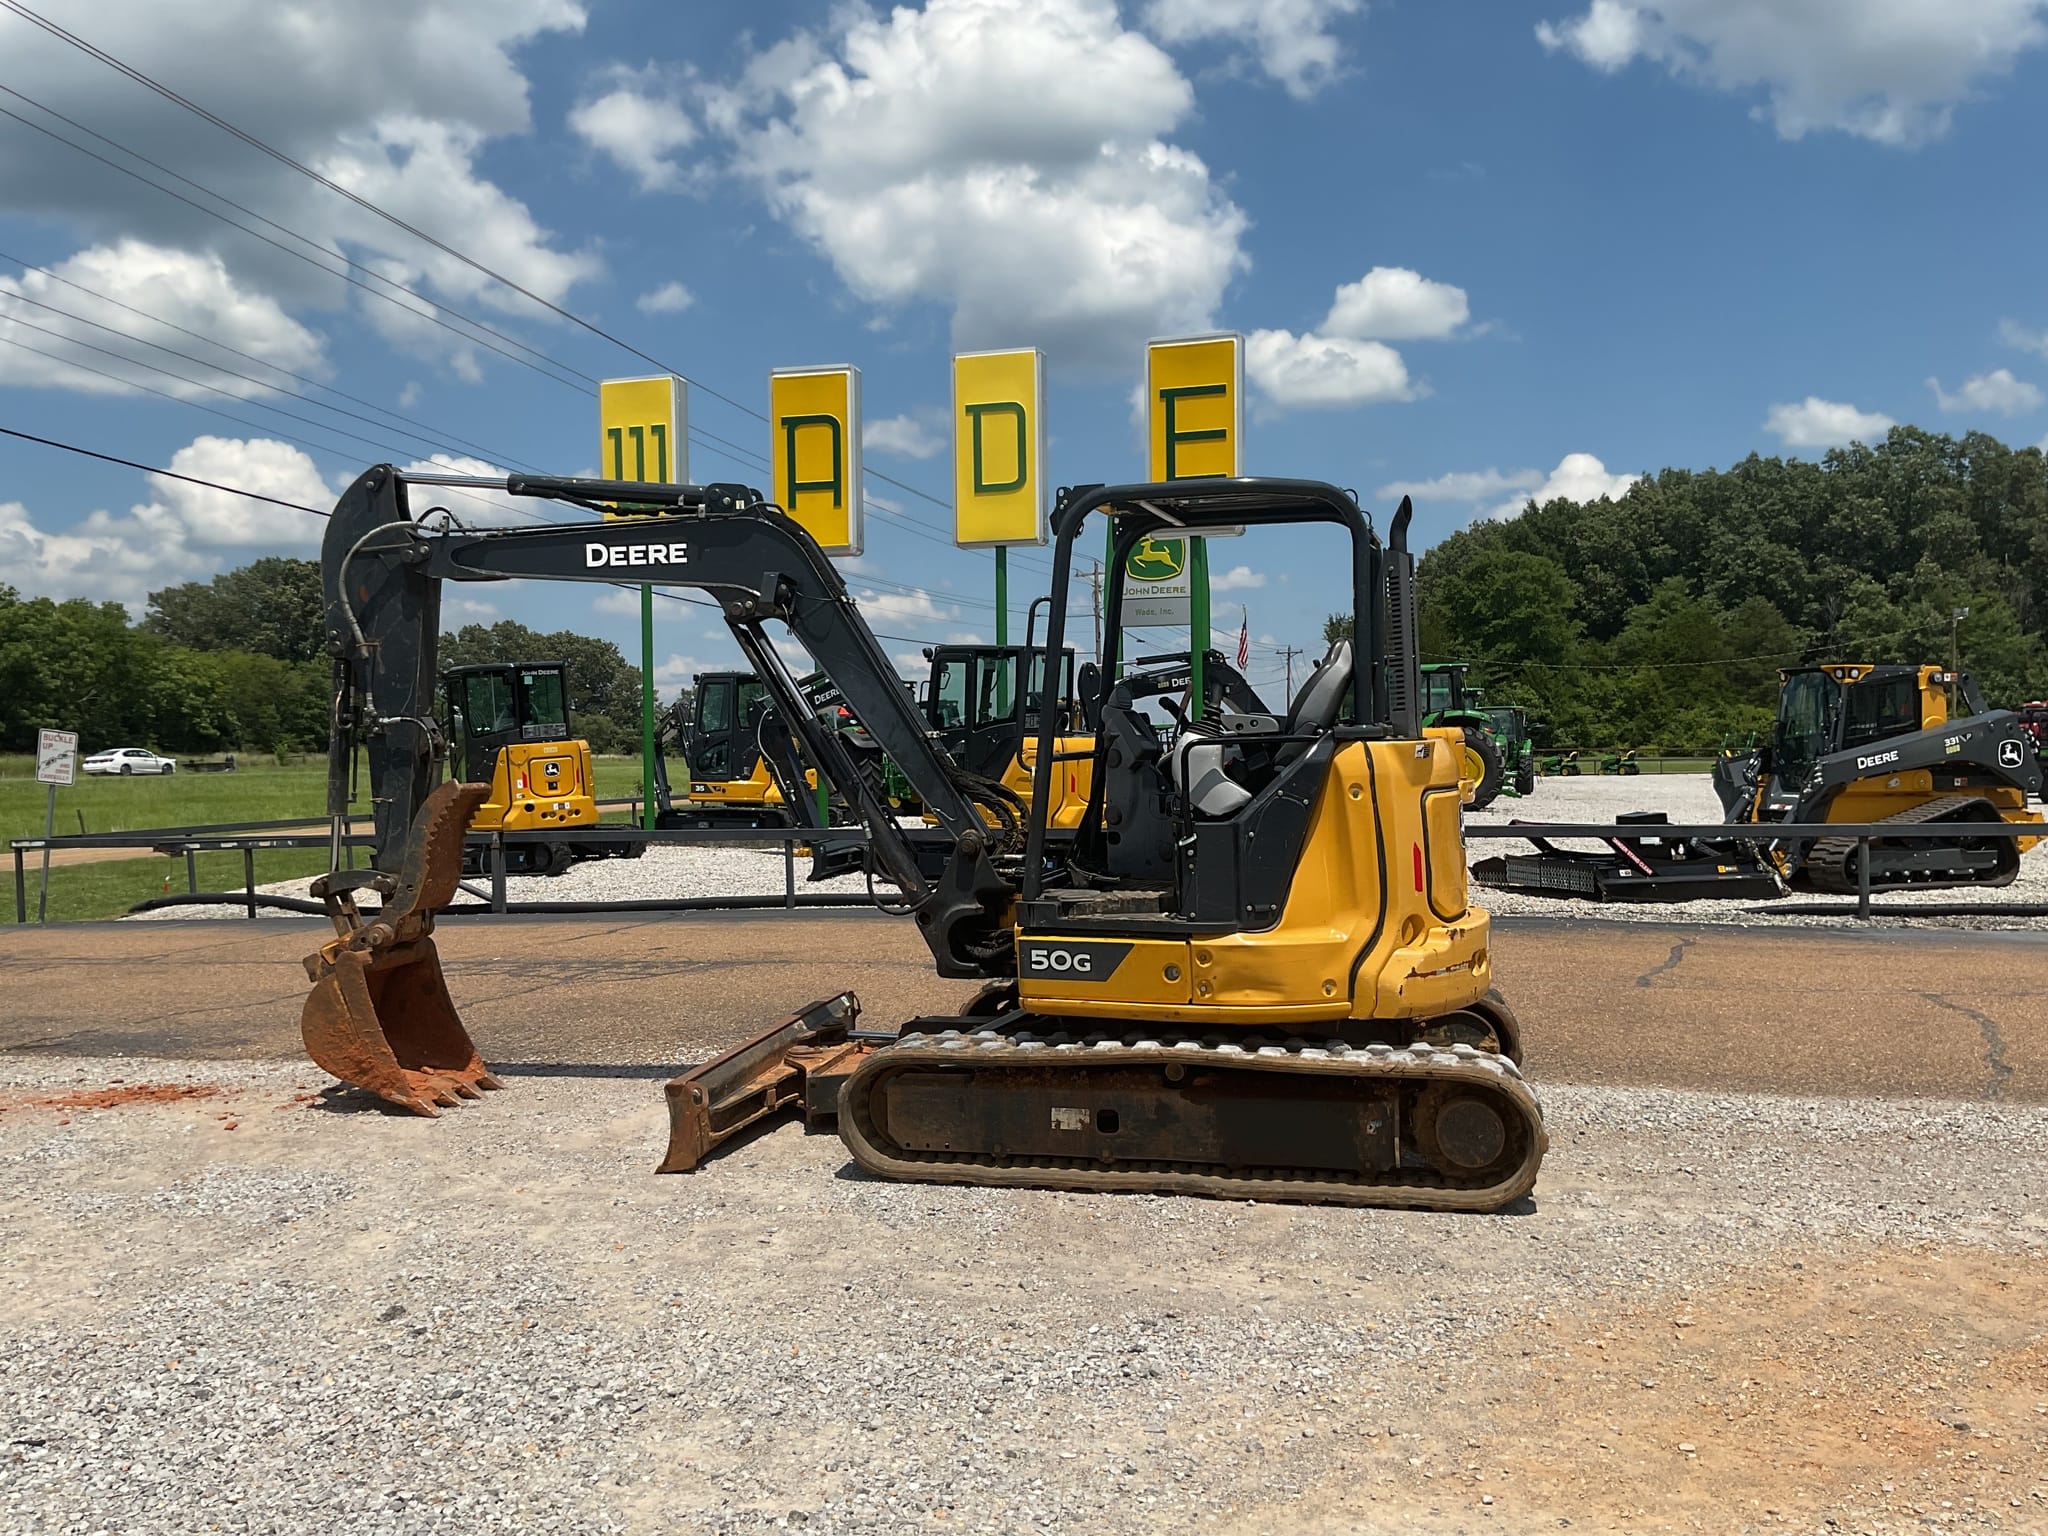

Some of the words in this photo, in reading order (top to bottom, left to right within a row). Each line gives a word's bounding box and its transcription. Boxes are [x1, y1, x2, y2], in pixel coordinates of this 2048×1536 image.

[585, 543, 688, 568] DEERE
[1123, 587, 1150, 595] JOHN
[1151, 585, 1186, 595] DEERE
[42, 742, 53, 750] UP
[43, 733, 73, 744] BUCKLE
[1857, 750, 1899, 769] DEERE
[1031, 949, 1091, 972] 50G
